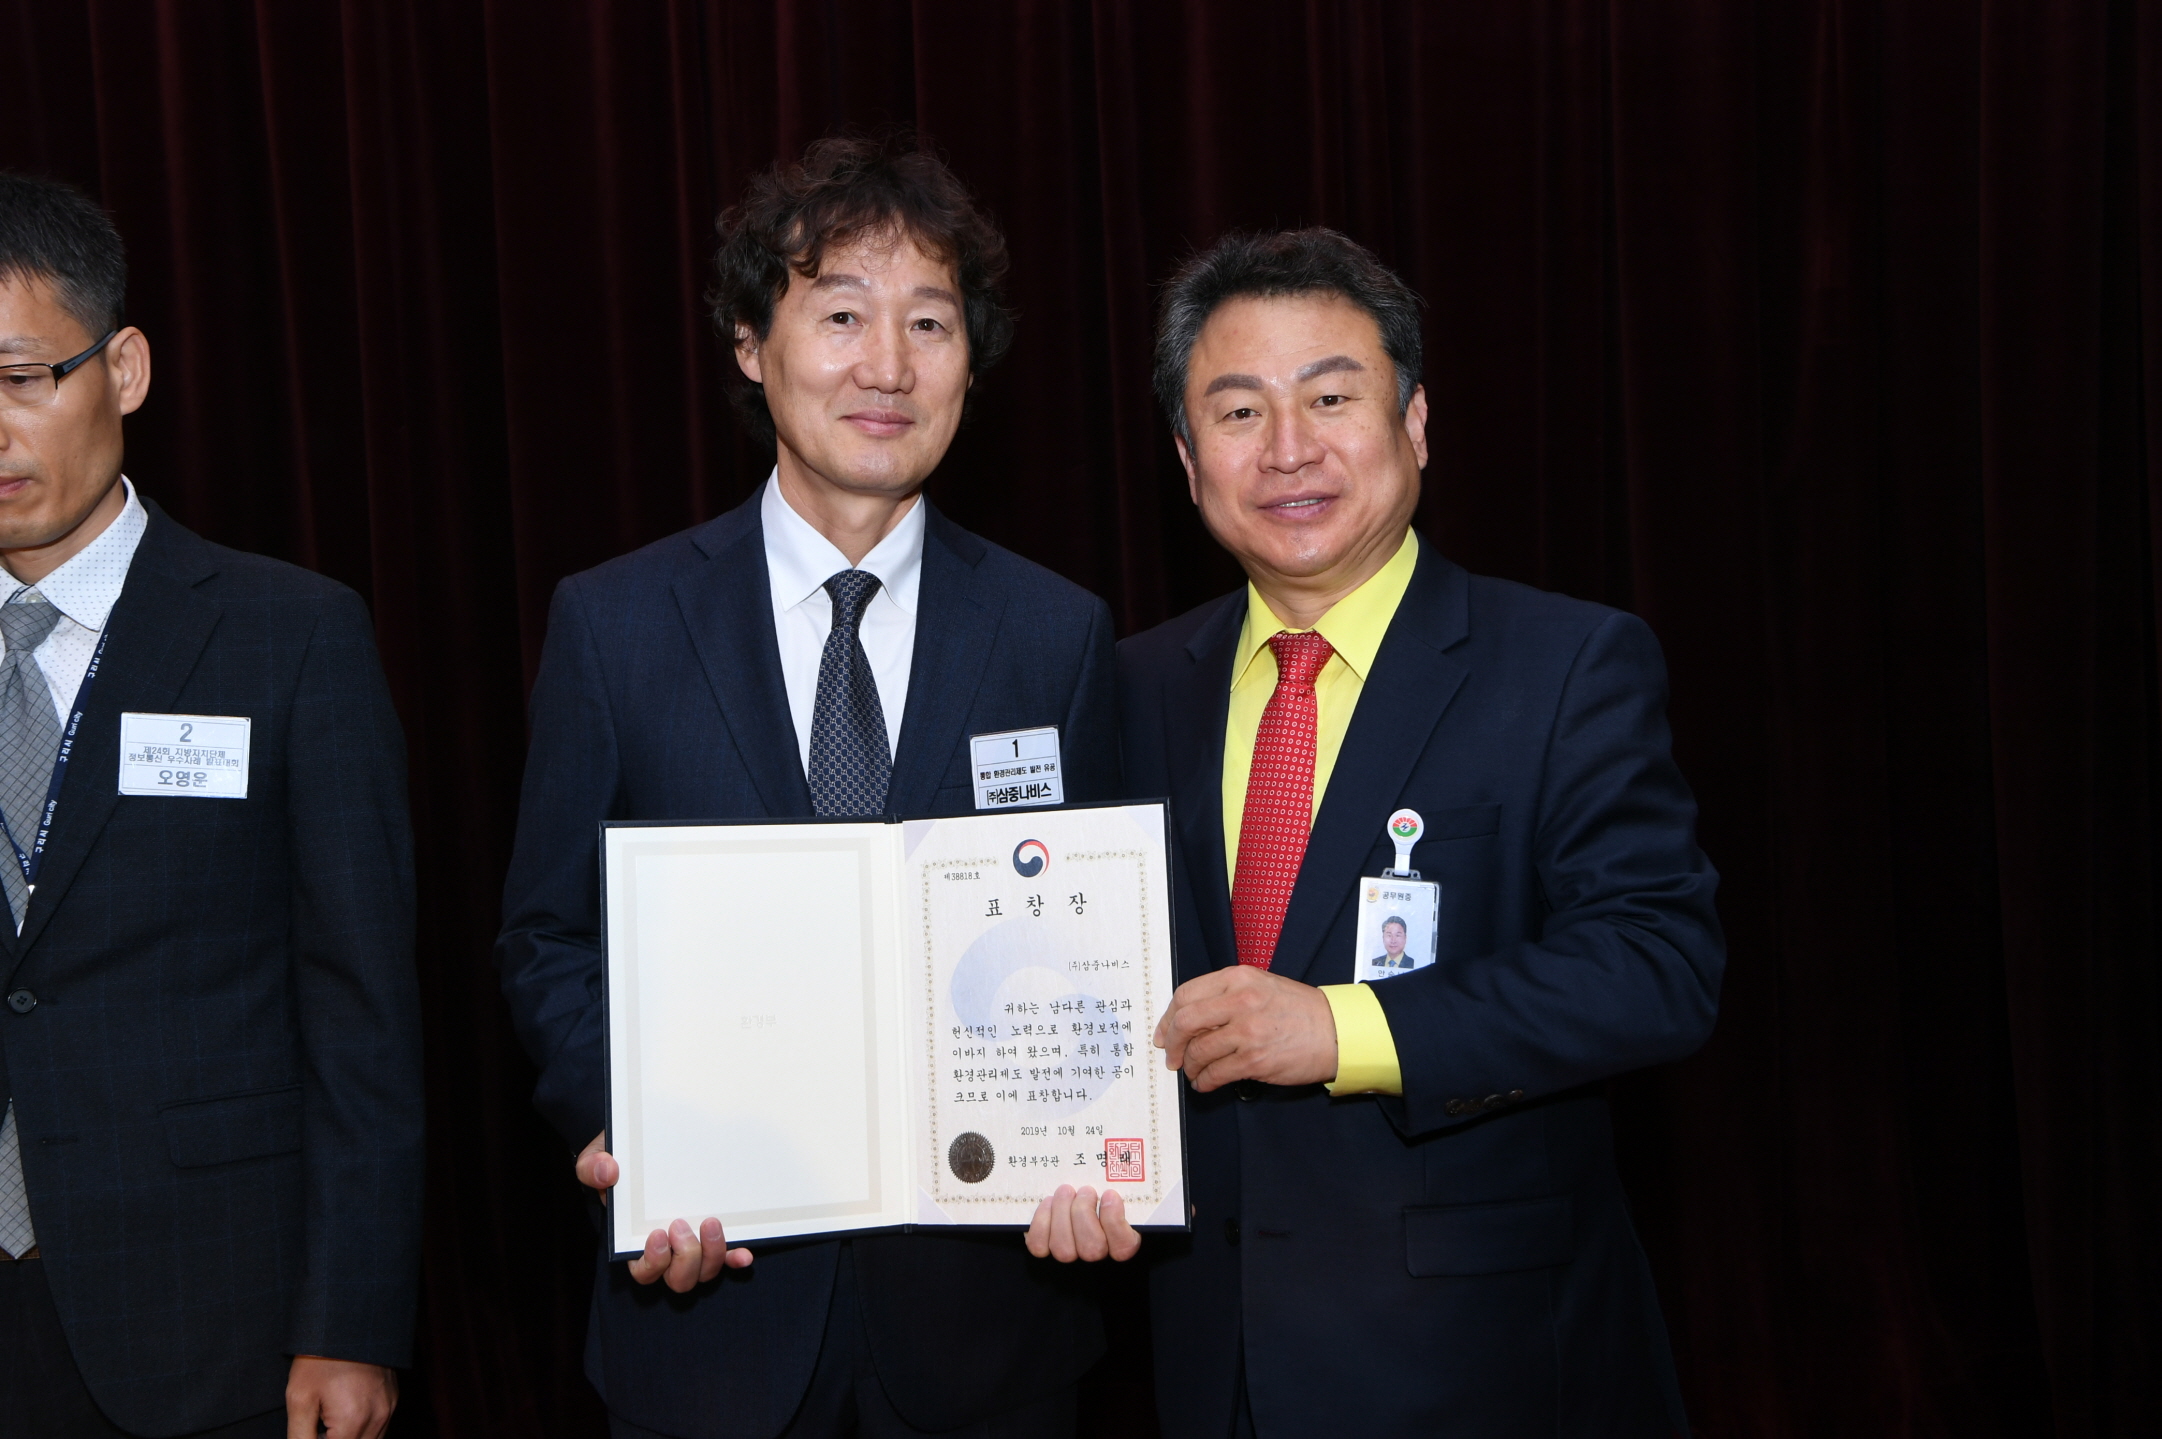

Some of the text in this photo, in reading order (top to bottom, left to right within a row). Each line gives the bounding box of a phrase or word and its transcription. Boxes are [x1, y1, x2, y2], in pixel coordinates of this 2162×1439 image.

[68, 711, 84, 736] Guri city
[180, 723, 193, 742] 2
[60, 740, 73, 763] 구리시
[144, 746, 170, 756] 제24회
[1012, 739, 1018, 758] 1
[129, 753, 162, 763] 정보통신
[167, 756, 201, 765] 우수사례
[158, 770, 208, 787] 오영운
[980, 763, 1055, 780] 통합 환경관리제도 발전 유공
[987, 782, 1052, 805] (주)삼중나비스
[43, 799, 58, 826] Guri city
[35, 830, 49, 853] 구리시
[944, 872, 980, 881] 제38818호
[1382, 891, 1412, 901] 공무원증
[1004, 999, 1132, 1015] 귀하는 남다른 관심과
[952, 1021, 1131, 1039] 헌신적인 노력으로 환경보전에
[953, 1047, 985, 1059] 이바지
[996, 1046, 1016, 1059] 하여
[1078, 1044, 1099, 1057] 특히
[1110, 1043, 1134, 1057] 통합
[954, 1065, 1133, 1082] 환경관리제도 발전에 기여한 공이
[954, 1088, 1092, 1102] 크므로 이에 표창합니다.
[1021, 1125, 1102, 1136] 2019년 10월 24일
[1009, 1156, 1059, 1167] 환경부장관
